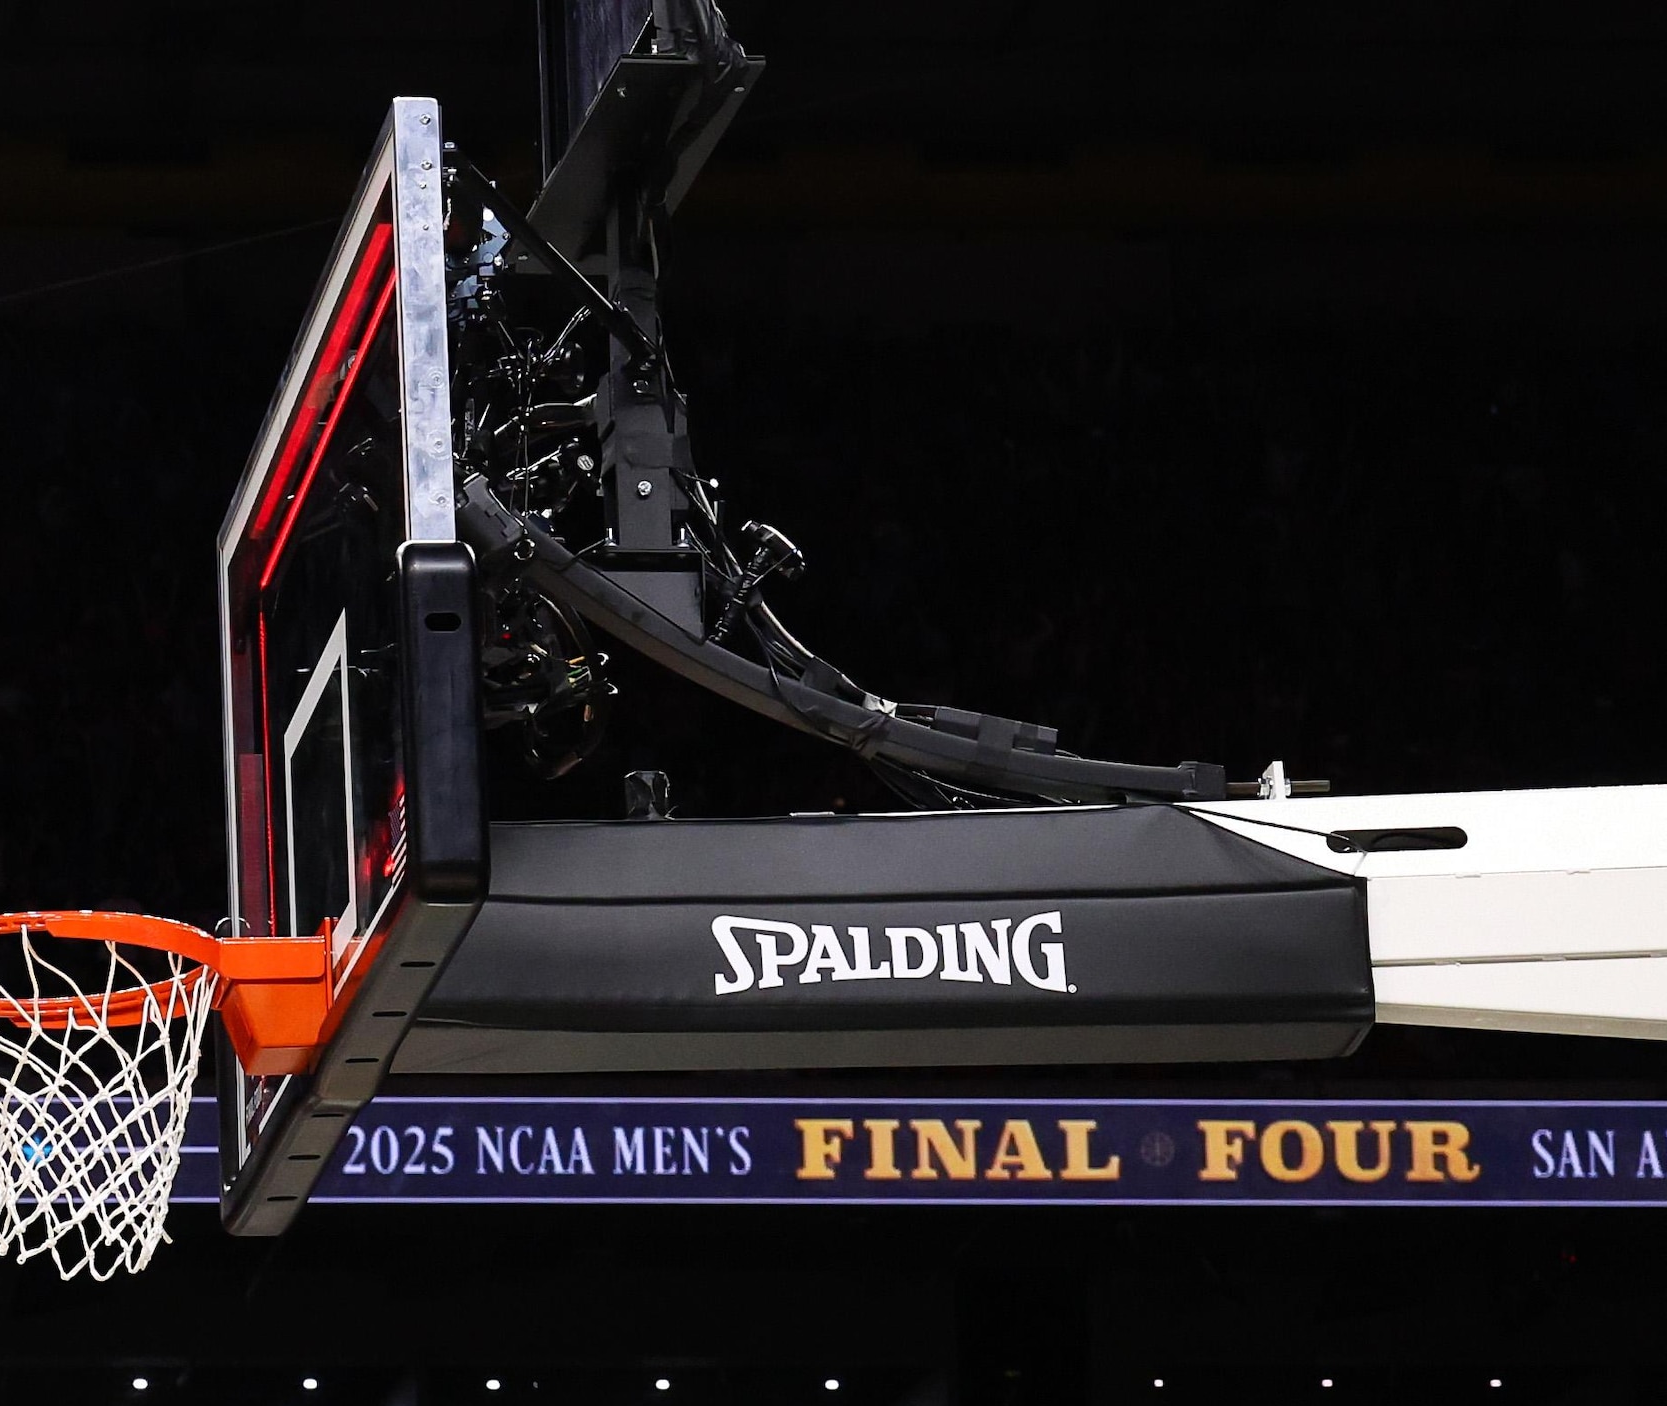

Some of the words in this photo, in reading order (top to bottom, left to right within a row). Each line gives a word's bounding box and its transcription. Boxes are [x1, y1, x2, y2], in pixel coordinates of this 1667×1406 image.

[711, 911, 1067, 994] SPALDING
[341, 1125, 455, 1175] 2025
[475, 1125, 596, 1175] NCAA
[612, 1126, 752, 1176] MEN'S
[793, 1118, 1121, 1181] FINAL
[1197, 1119, 1481, 1182] FOUR
[1531, 1128, 1615, 1179] SAN
[1635, 1130, 1667, 1179] A
